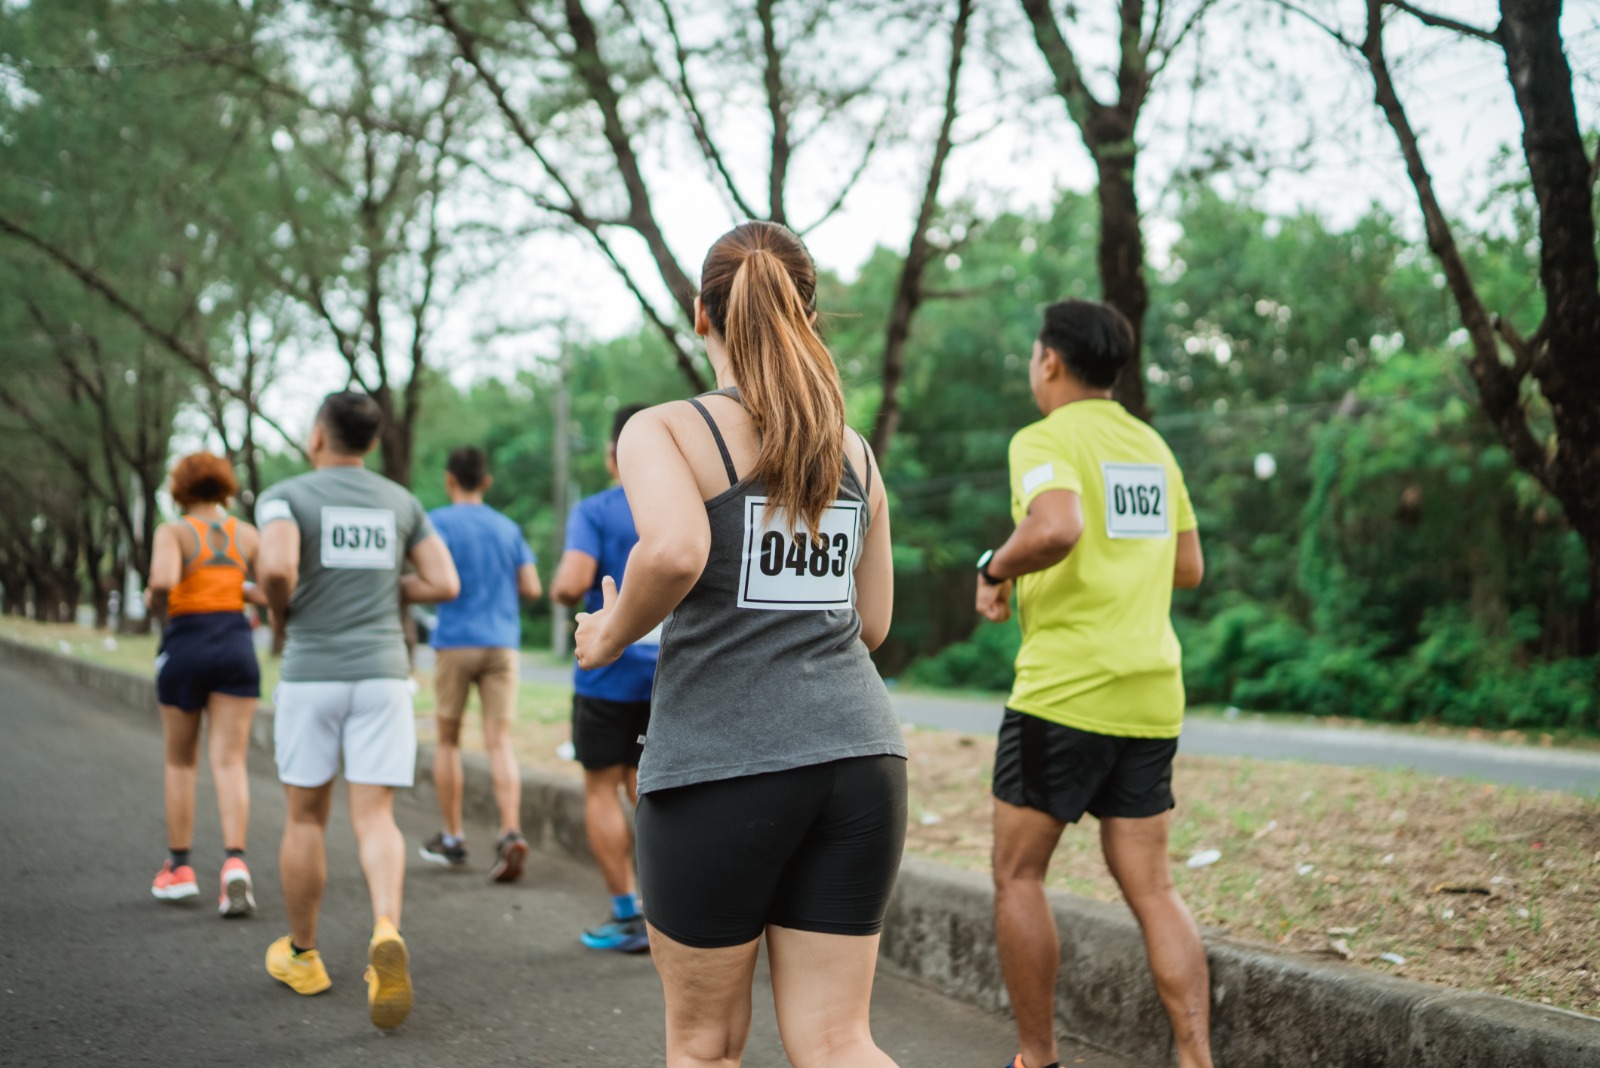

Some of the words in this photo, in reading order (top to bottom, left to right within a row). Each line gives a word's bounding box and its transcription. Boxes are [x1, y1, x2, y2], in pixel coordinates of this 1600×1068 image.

[1114, 484, 1161, 515] 0162
[332, 525, 387, 549] 0376
[760, 530, 848, 577] 0483
